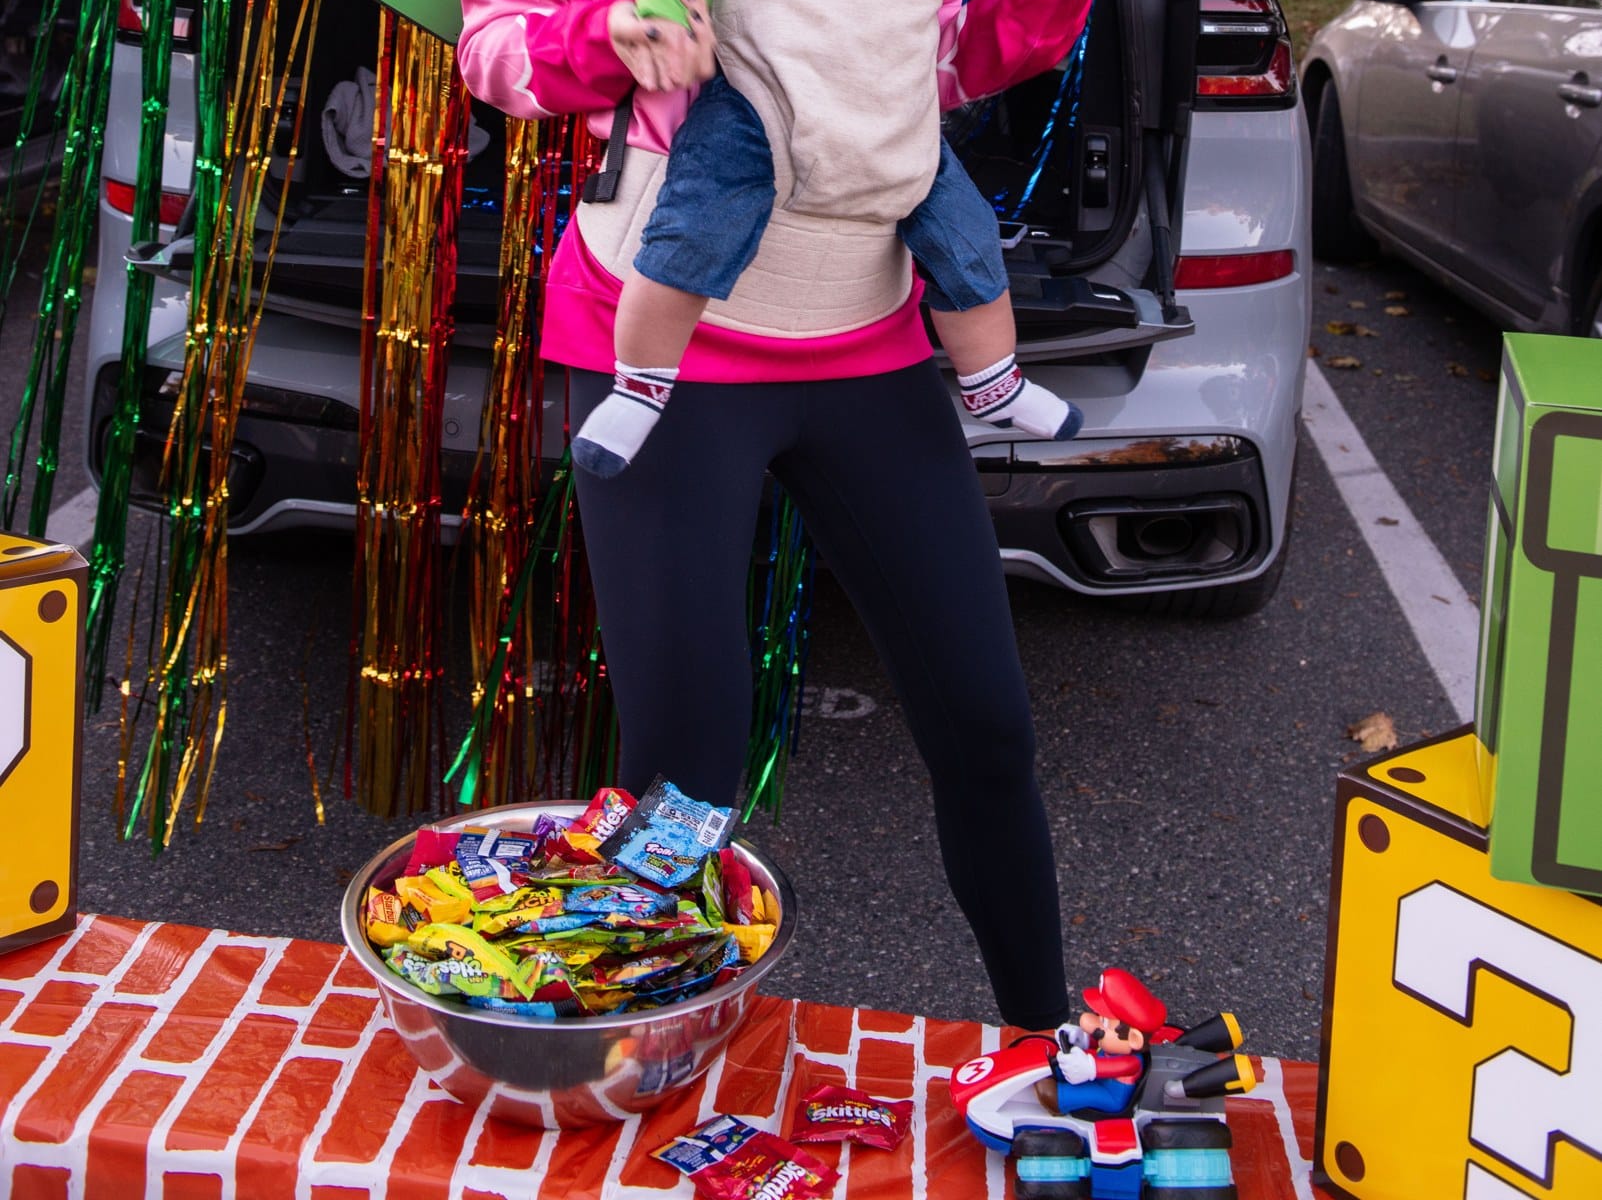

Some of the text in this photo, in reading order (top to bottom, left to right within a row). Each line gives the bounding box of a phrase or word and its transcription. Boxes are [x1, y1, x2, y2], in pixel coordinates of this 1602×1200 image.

[963, 373, 1018, 409] VANS
[591, 802, 629, 842] ttles
[645, 843, 677, 857] Trolli
[383, 894, 395, 924] Starbur
[811, 1103, 893, 1130] Skittles
[751, 1160, 806, 1200] Skittle
